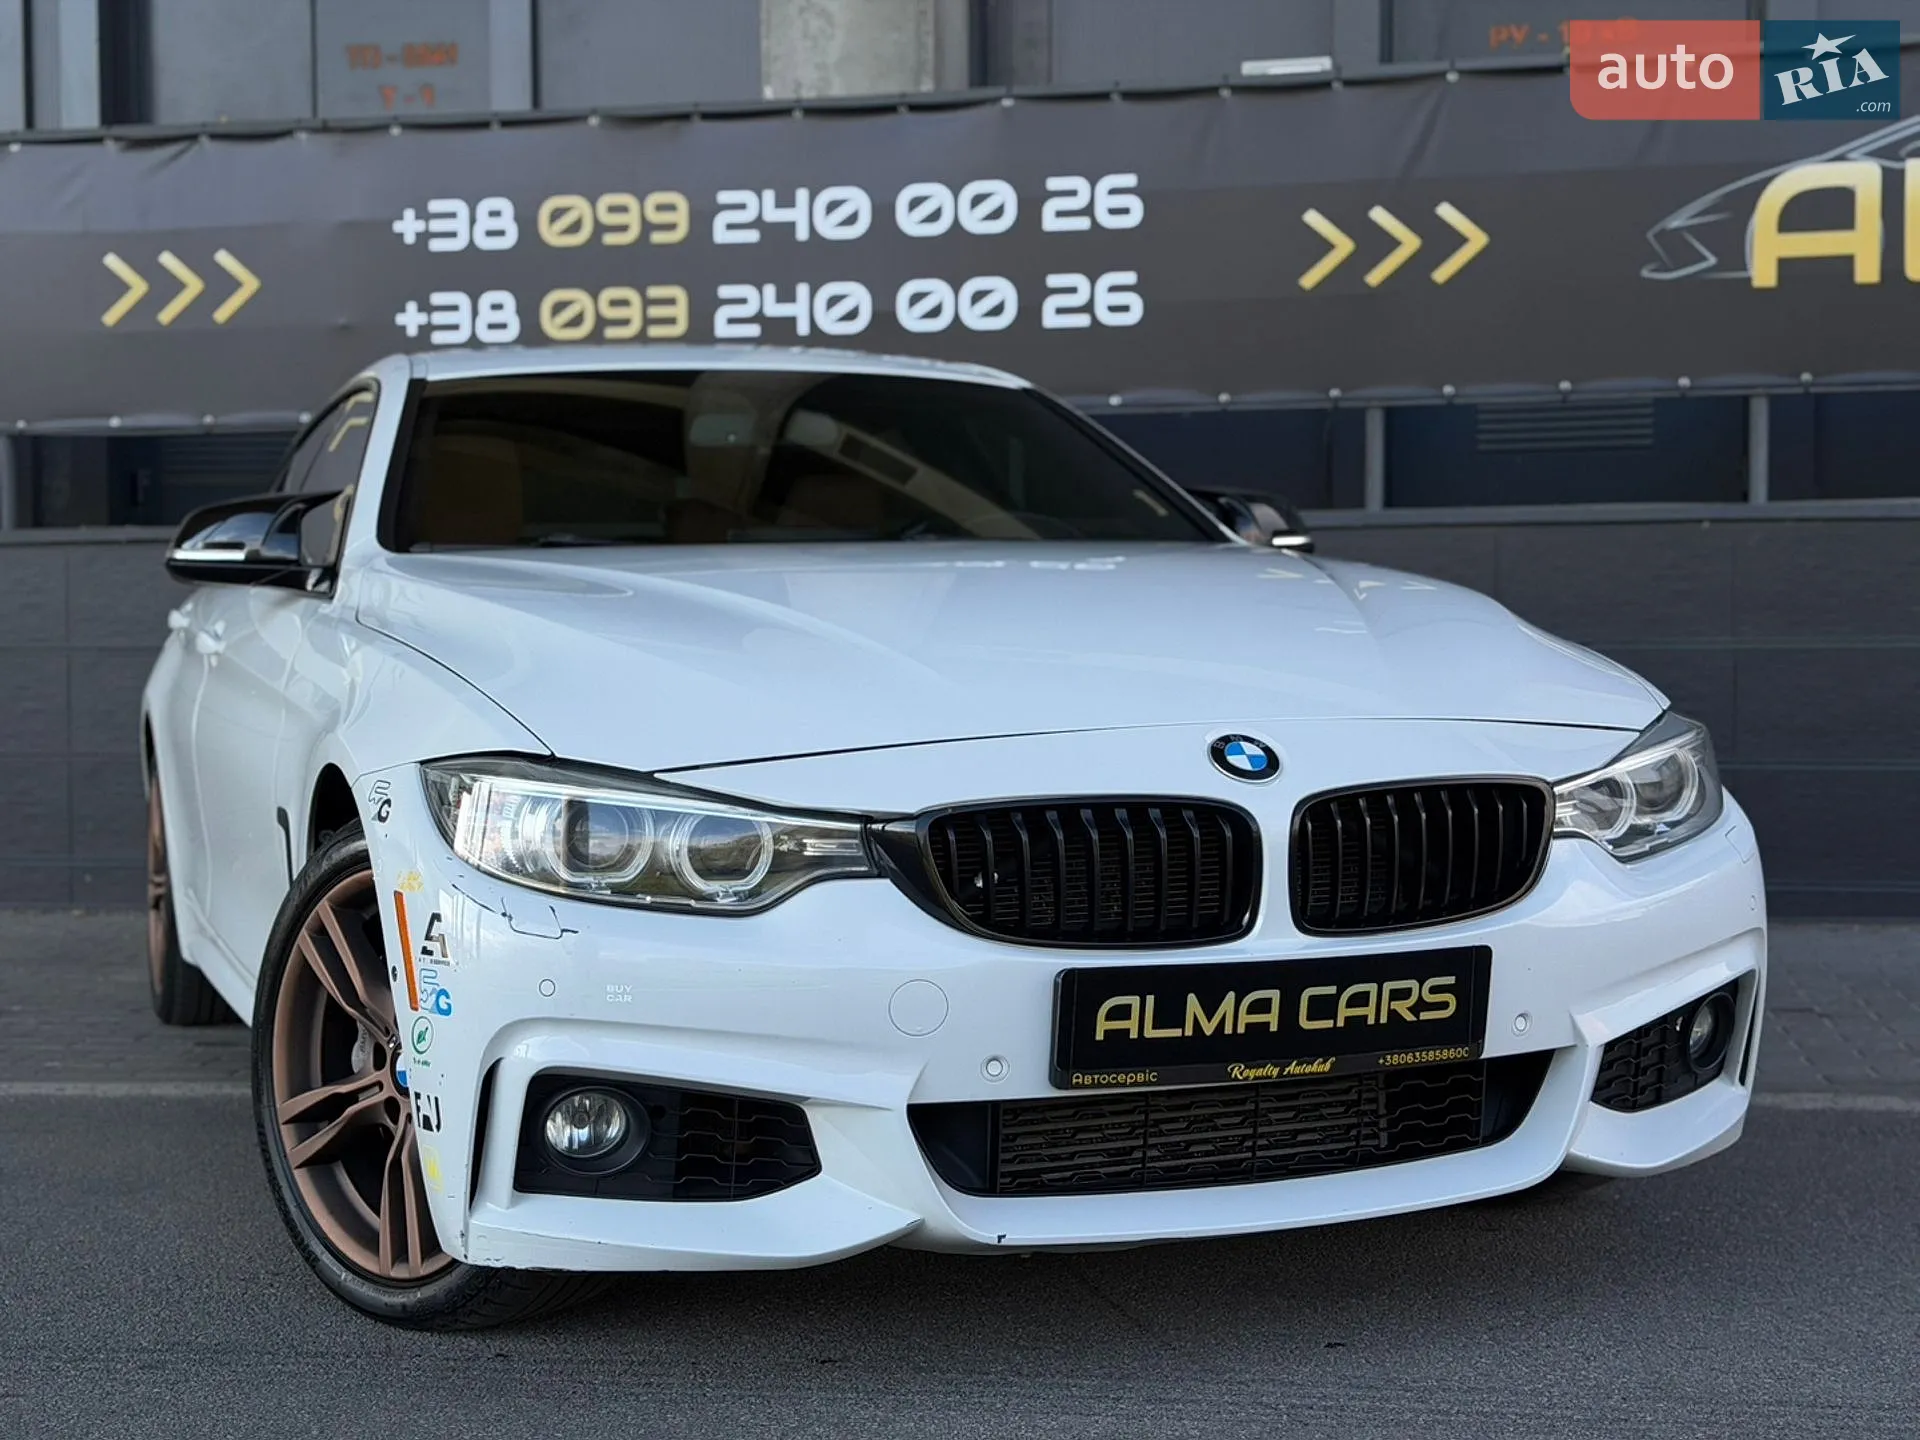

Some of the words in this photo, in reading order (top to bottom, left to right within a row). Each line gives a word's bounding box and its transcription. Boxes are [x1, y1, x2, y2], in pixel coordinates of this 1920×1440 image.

[393, 197, 518, 252] +38
[538, 191, 690, 247] 099
[713, 185, 872, 244] 240
[895, 179, 1018, 237] 00
[1041, 173, 1144, 232] 26
[1751, 158, 1920, 288] A
[395, 291, 520, 345] +38
[539, 285, 689, 341] 093
[714, 281, 873, 338] 240
[895, 276, 1018, 333] 00
[1042, 270, 1144, 329] 26
[606, 984, 633, 993] BUY
[606, 994, 633, 1003] CAR
[1095, 988, 1281, 1041] ALMA
[1299, 976, 1456, 1030] CARS
[1072, 1069, 1158, 1086] Автосервіс
[1227, 1062, 1280, 1081] Royalty
[1282, 1056, 1336, 1076] Autohub
